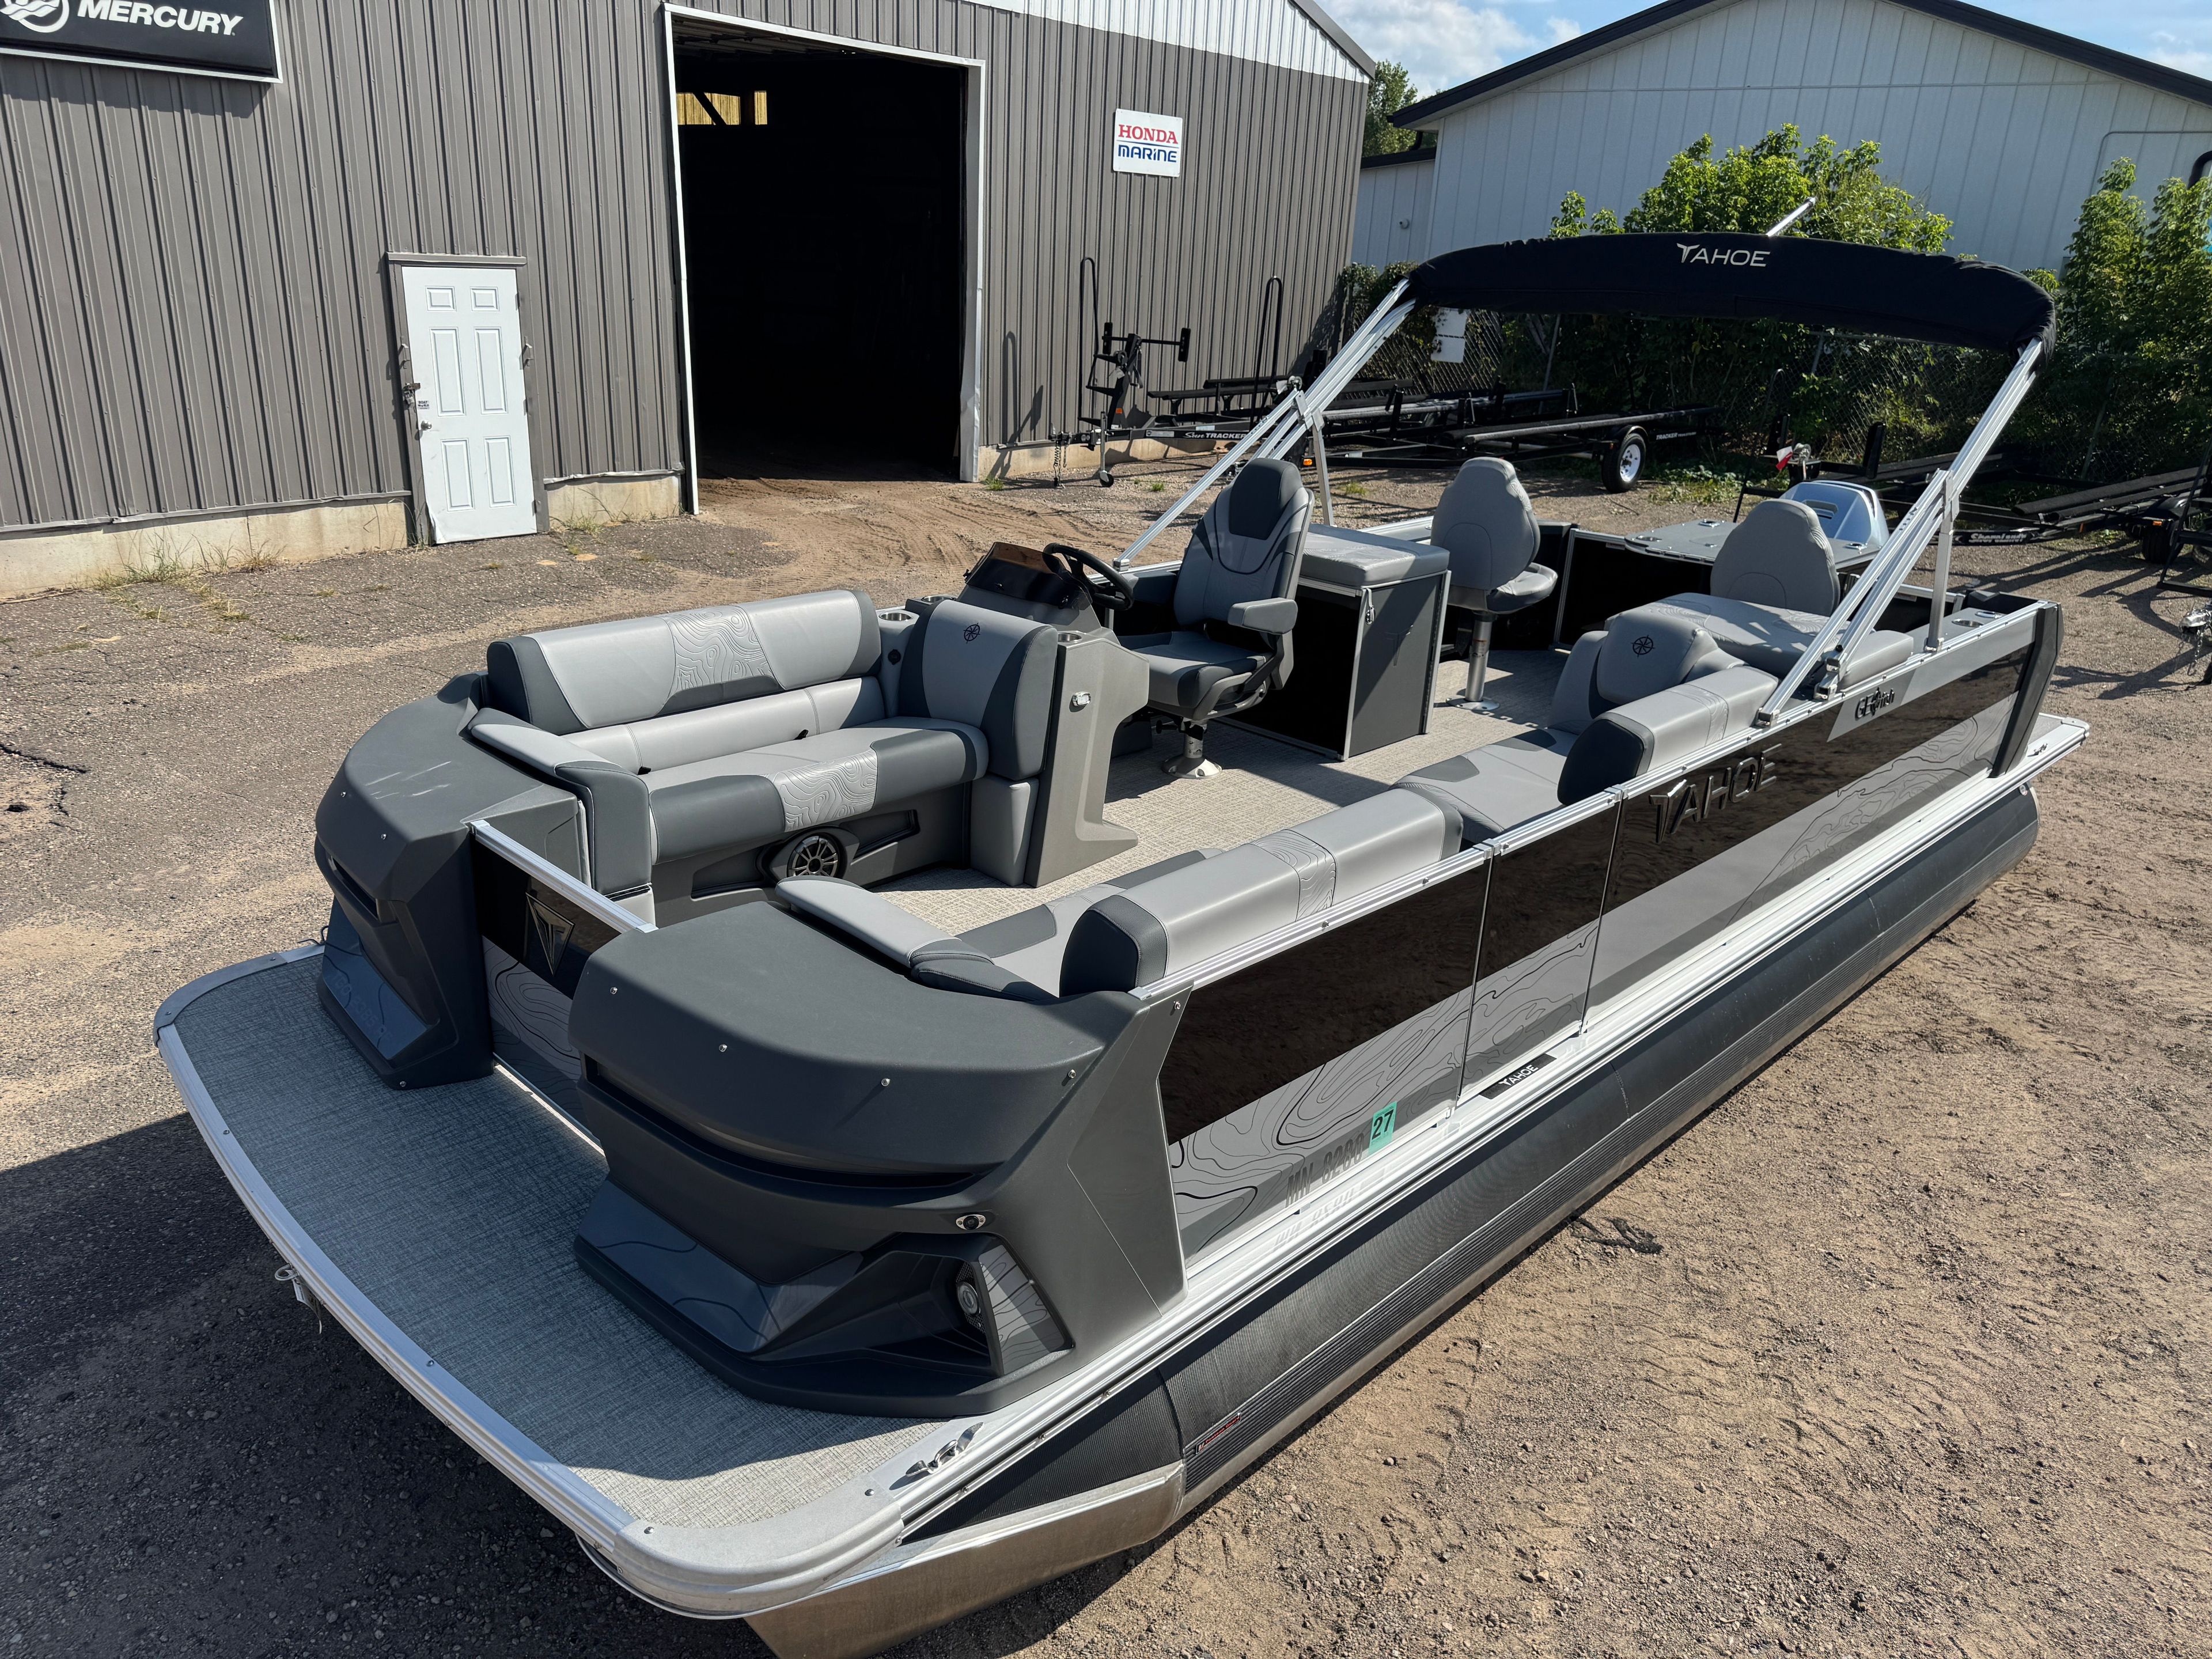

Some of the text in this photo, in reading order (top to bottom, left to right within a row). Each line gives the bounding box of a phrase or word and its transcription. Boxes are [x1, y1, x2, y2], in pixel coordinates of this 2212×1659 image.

[77, 0, 244, 36] MERCURY
[1118, 124, 1179, 144] HONDA
[1676, 243, 1771, 267] TAHOE
[1649, 743, 1782, 843] TAHOE
[1498, 1065, 1539, 1086] TAHOE
[1372, 1109, 1394, 1140] 27
[1286, 1162, 1314, 1208] MN
